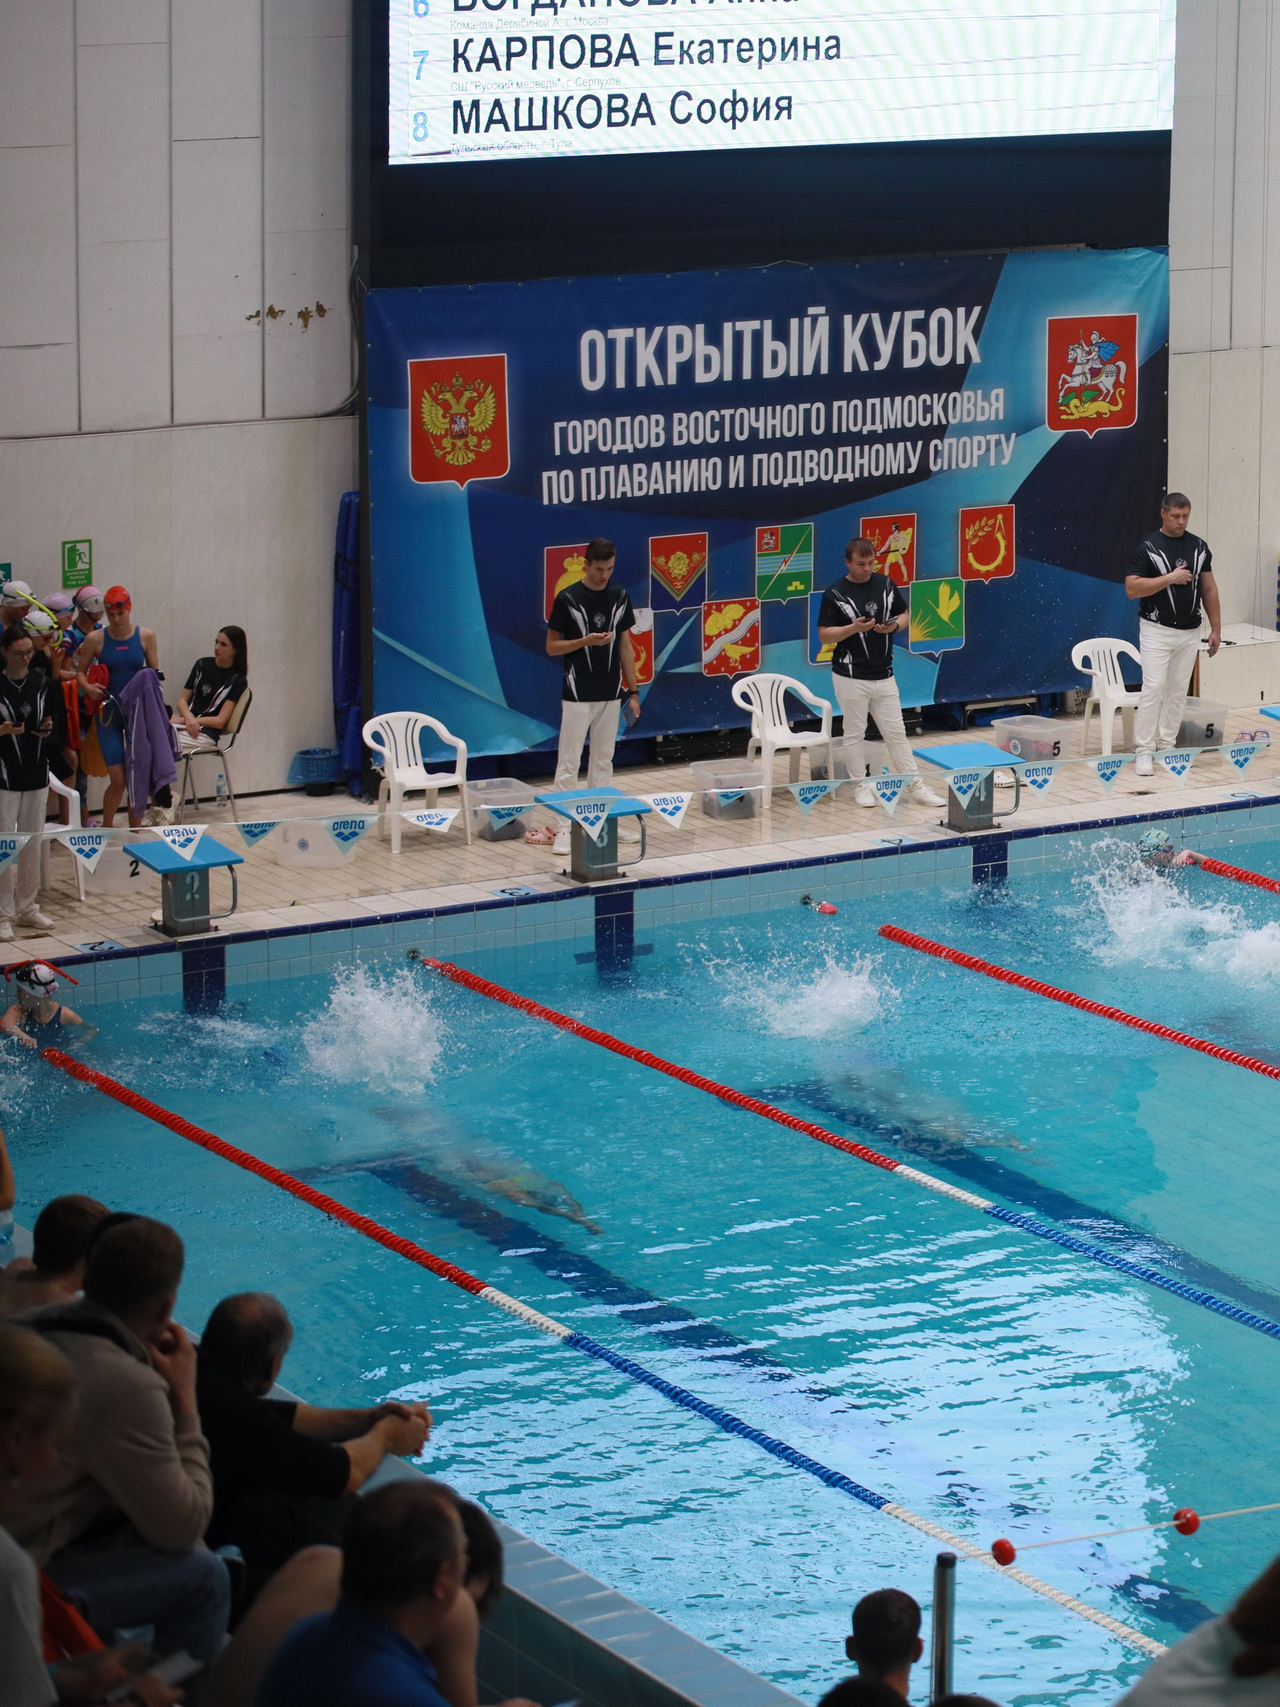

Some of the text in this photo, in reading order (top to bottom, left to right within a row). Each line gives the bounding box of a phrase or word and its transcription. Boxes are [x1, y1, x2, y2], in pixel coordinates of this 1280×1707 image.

[453, 31, 841, 73] КАРПОВА Екатерина
[413, 50, 429, 80] 7
[575, 77, 621, 91] Серпухов
[453, 89, 793, 134] МАШКОВА София
[412, 112, 429, 142] 8
[550, 138, 573, 151] Тула
[580, 305, 982, 391] ОТКРЫТЫЙ КУБОК
[553, 388, 1005, 456] ГОРОДОВ ВОСТОЧНОГО ПОДМОСКОВЬЯ
[542, 433, 1017, 505] ПО ПЛАВАНИЮ И ПОДВОДНОМУ СПОРТУ
[1205, 723, 1215, 739] 5
[1052, 741, 1061, 757] 5
[1230, 746, 1255, 759] arena
[1164, 753, 1190, 765] arena
[1025, 766, 1053, 778] arena
[1097, 760, 1122, 772] arena
[876, 779, 902, 791] arena
[953, 773, 979, 785] arena
[799, 785, 828, 797] arena
[653, 795, 684, 807] arena
[575, 803, 605, 815] arena
[332, 819, 365, 831] arena
[163, 827, 197, 839] arena
[69, 834, 102, 846] arena
[129, 860, 140, 877] 2
[185, 871, 200, 900] 2
